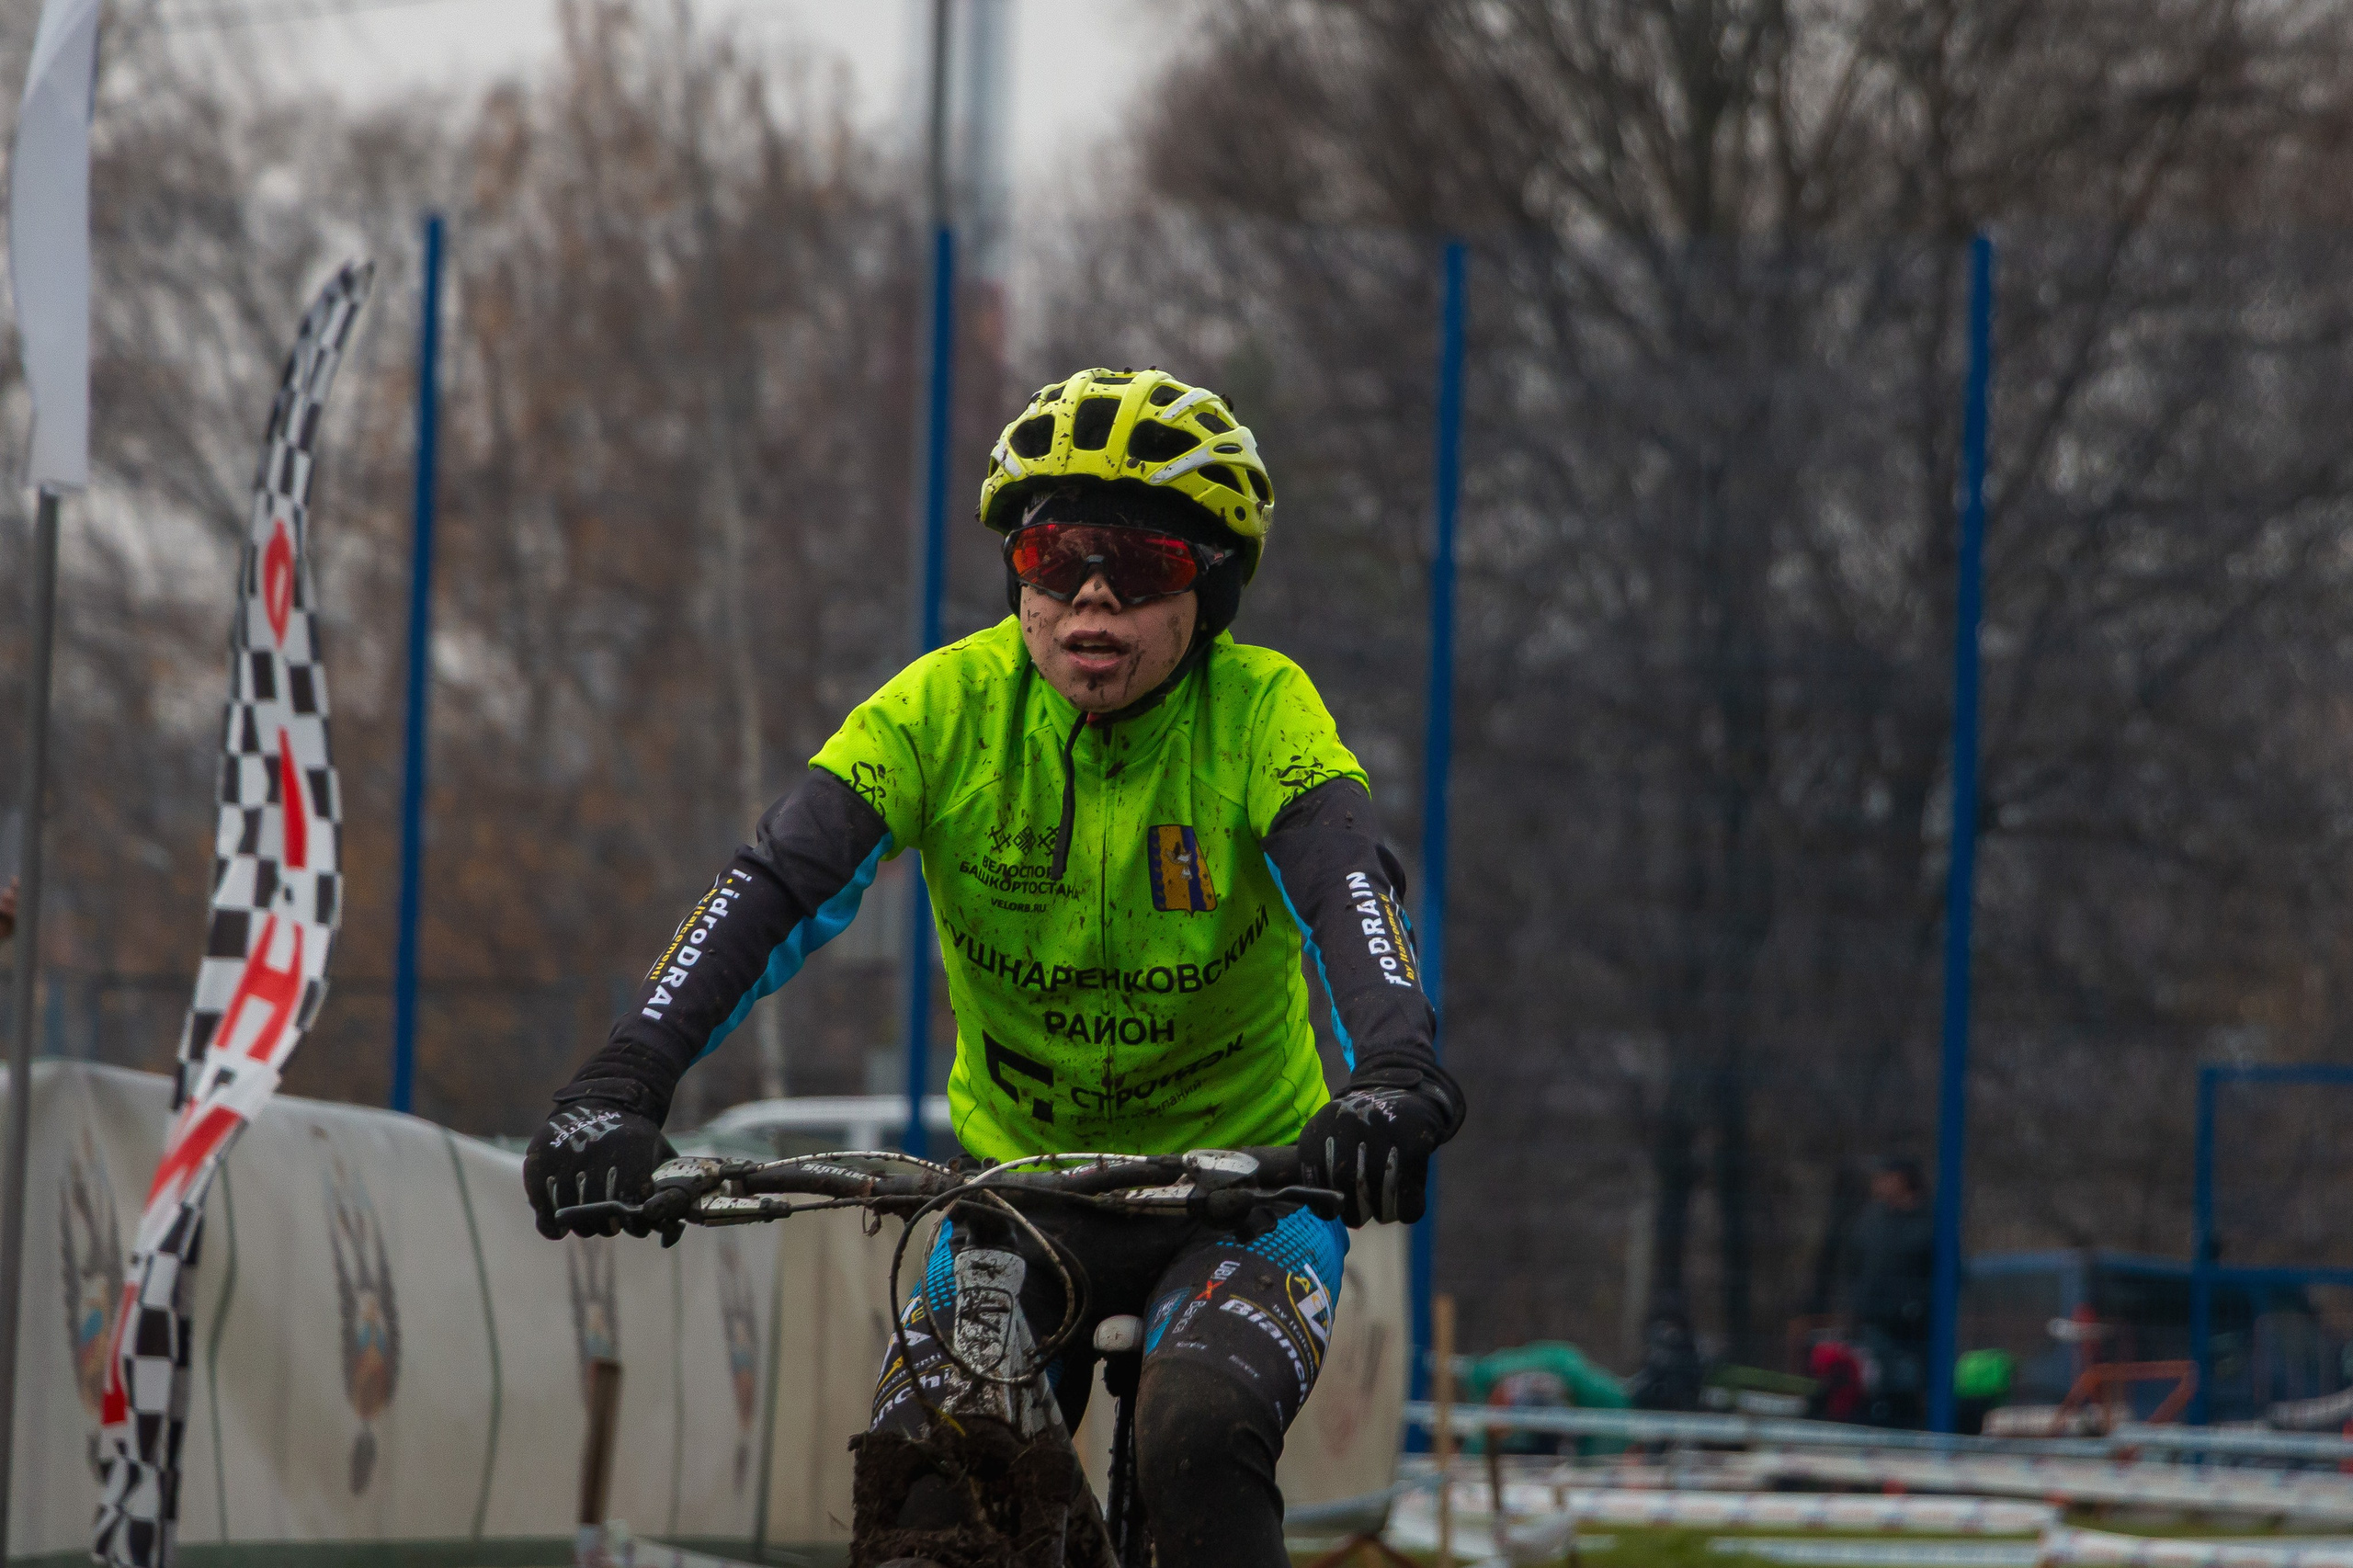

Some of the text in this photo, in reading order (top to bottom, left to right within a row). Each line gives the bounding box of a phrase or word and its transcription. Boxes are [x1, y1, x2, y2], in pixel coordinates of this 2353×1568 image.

[982, 854, 1053, 879] ВЕЛОСПО
[641, 868, 753, 1021] i.idroDRAI
[1043, 1009, 1175, 1046] РАЙОН
